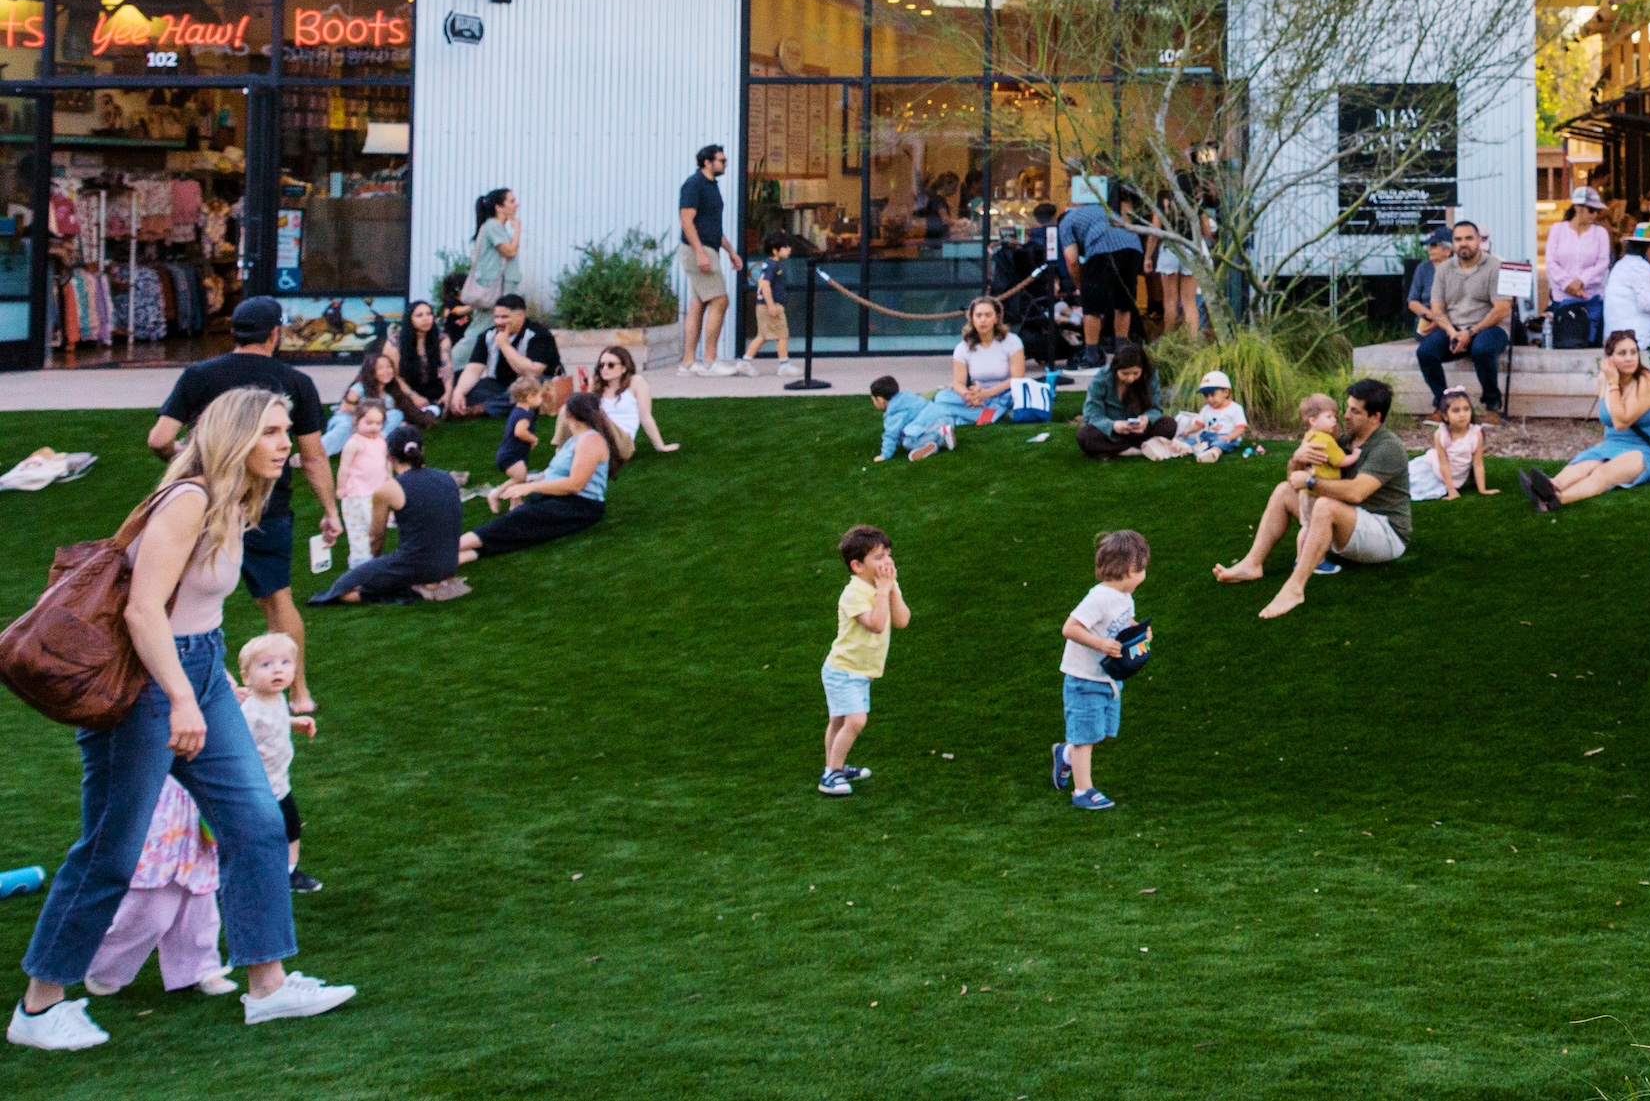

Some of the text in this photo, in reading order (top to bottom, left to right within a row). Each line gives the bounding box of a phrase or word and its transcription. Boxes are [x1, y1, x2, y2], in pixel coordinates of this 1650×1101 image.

[92, 14, 250, 55] Yee Haw!
[295, 8, 408, 47] Boots
[146, 51, 178, 68] 102
